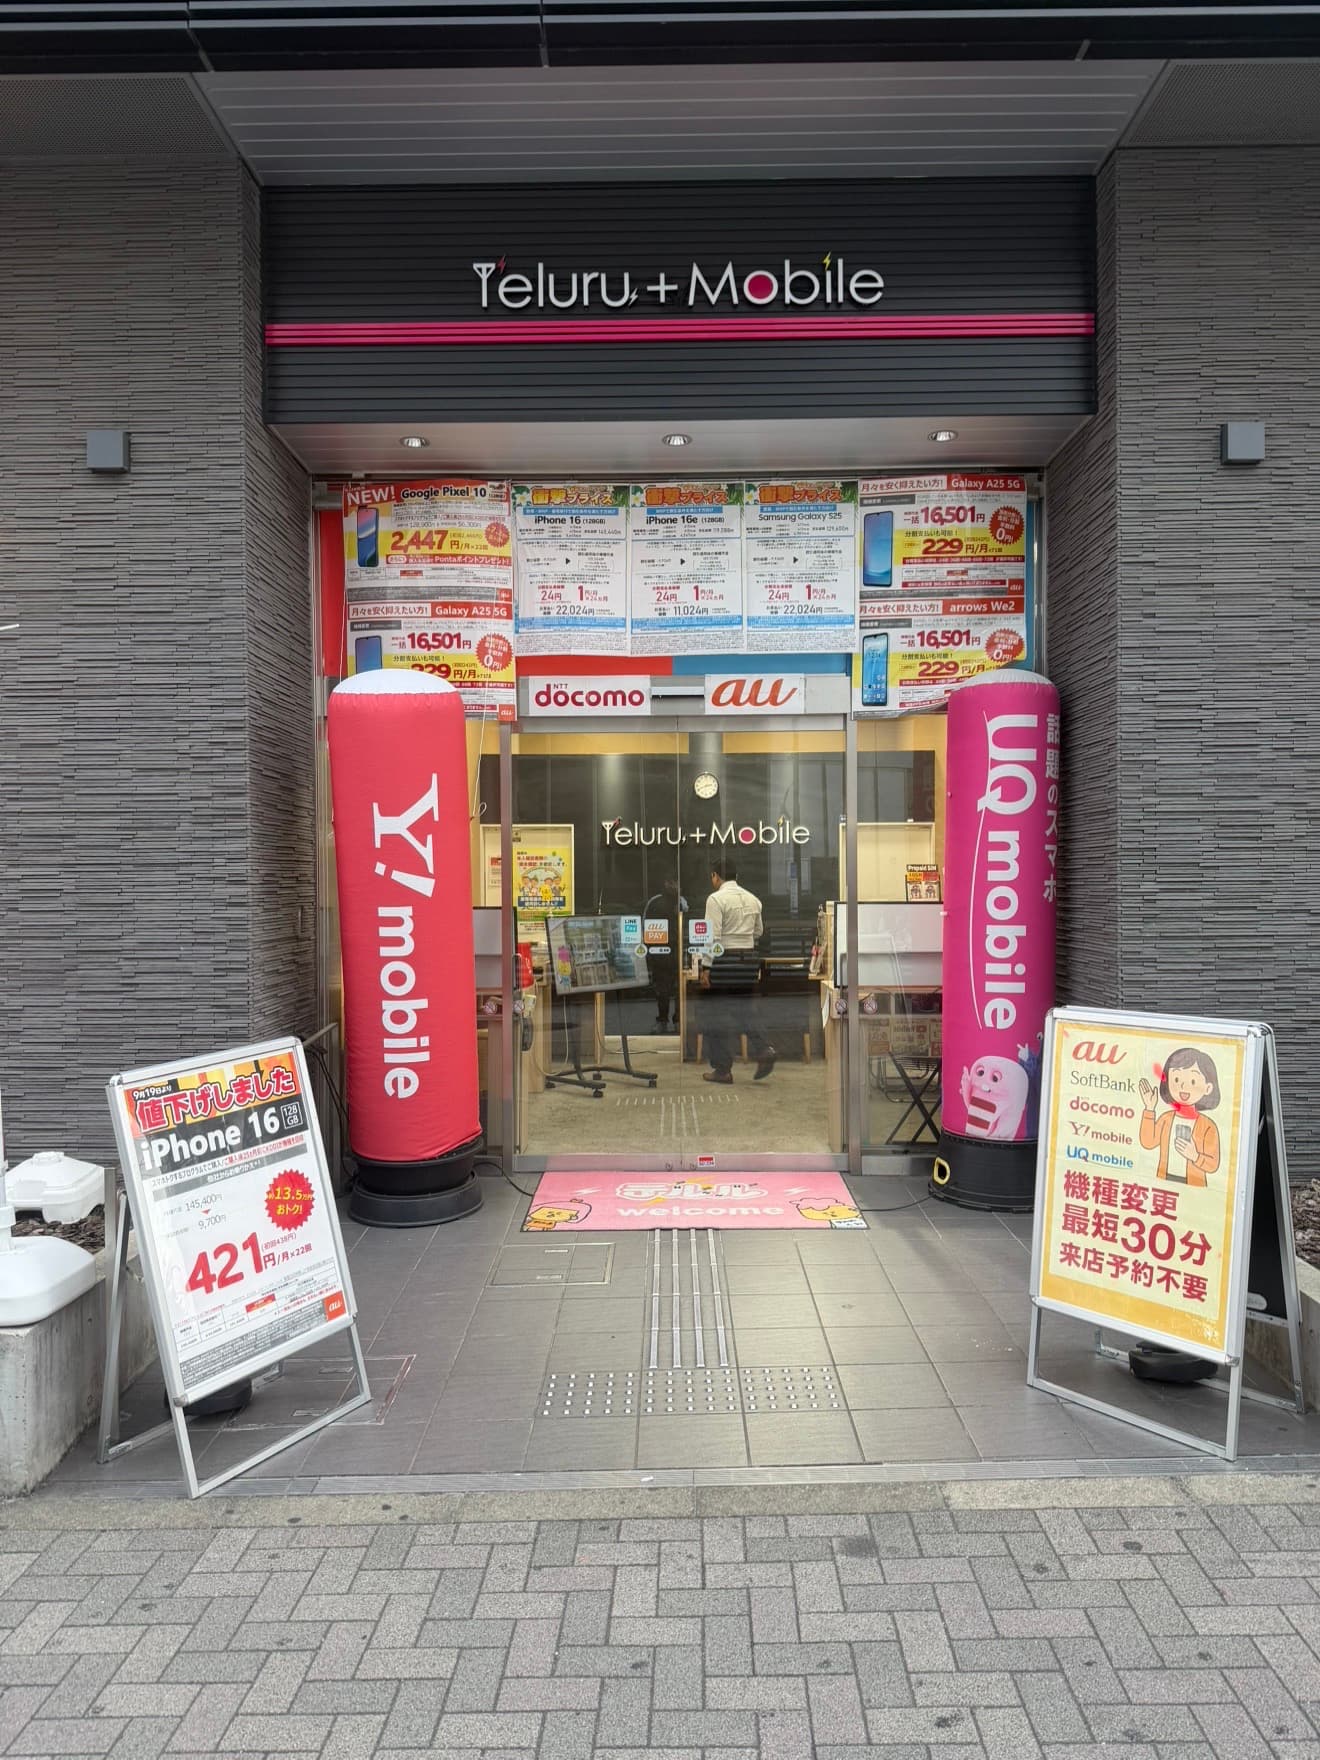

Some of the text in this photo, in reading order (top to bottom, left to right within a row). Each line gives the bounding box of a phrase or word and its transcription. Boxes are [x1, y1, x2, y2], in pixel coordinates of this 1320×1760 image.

[688, 256, 884, 306] Mobile
[951, 478, 1020, 490] Galaxy A25 5G
[347, 486, 395, 506] NEW!
[402, 487, 439, 500] Google
[443, 486, 469, 497] Pixel
[473, 487, 487, 497] 10
[534, 516, 566, 525] iPhone
[570, 516, 581, 524] 16
[646, 516, 678, 525] iPhone
[681, 515, 698, 524] 16e
[758, 512, 842, 522] Samsung Galaxy S25
[921, 506, 985, 526] 16,501円
[541, 590, 561, 600] 24円
[656, 591, 677, 602] 24円
[768, 589, 789, 600] 24円
[435, 606, 507, 617] Galaxy A25 5G
[555, 605, 595, 616] 22,024円
[673, 605, 709, 616] 11,024円
[783, 604, 823, 615] 22,024円
[950, 601, 1015, 613] arrows We2
[407, 632, 472, 651] 16,501円
[917, 629, 981, 649] 16,501円
[534, 684, 645, 707] docomo
[711, 678, 798, 707] au
[710, 819, 810, 845] Mobile
[977, 713, 1038, 1031] UQ mobile
[648, 932, 664, 940] PAY
[377, 905, 431, 1100] mobile
[1072, 1040, 1127, 1065] au
[1070, 1071, 1136, 1094] SoftBank
[133, 1085, 172, 1101] 9月19日より
[136, 1066, 295, 1132] 値下げしました
[283, 1102, 298, 1115] 128
[1069, 1096, 1135, 1119] docomo
[287, 1114, 299, 1125] GB
[141, 1107, 280, 1170] iPhone 16
[1091, 1129, 1133, 1146] mobile
[1067, 1145, 1134, 1168] UQ mobile
[1063, 1169, 1180, 1221] 機種変更
[276, 1206, 303, 1216] おトク!
[618, 1204, 785, 1217] welcome
[1061, 1203, 1212, 1266] 最短30分
[1059, 1242, 1208, 1302] 来店予約不要
[328, 1301, 344, 1312] au
